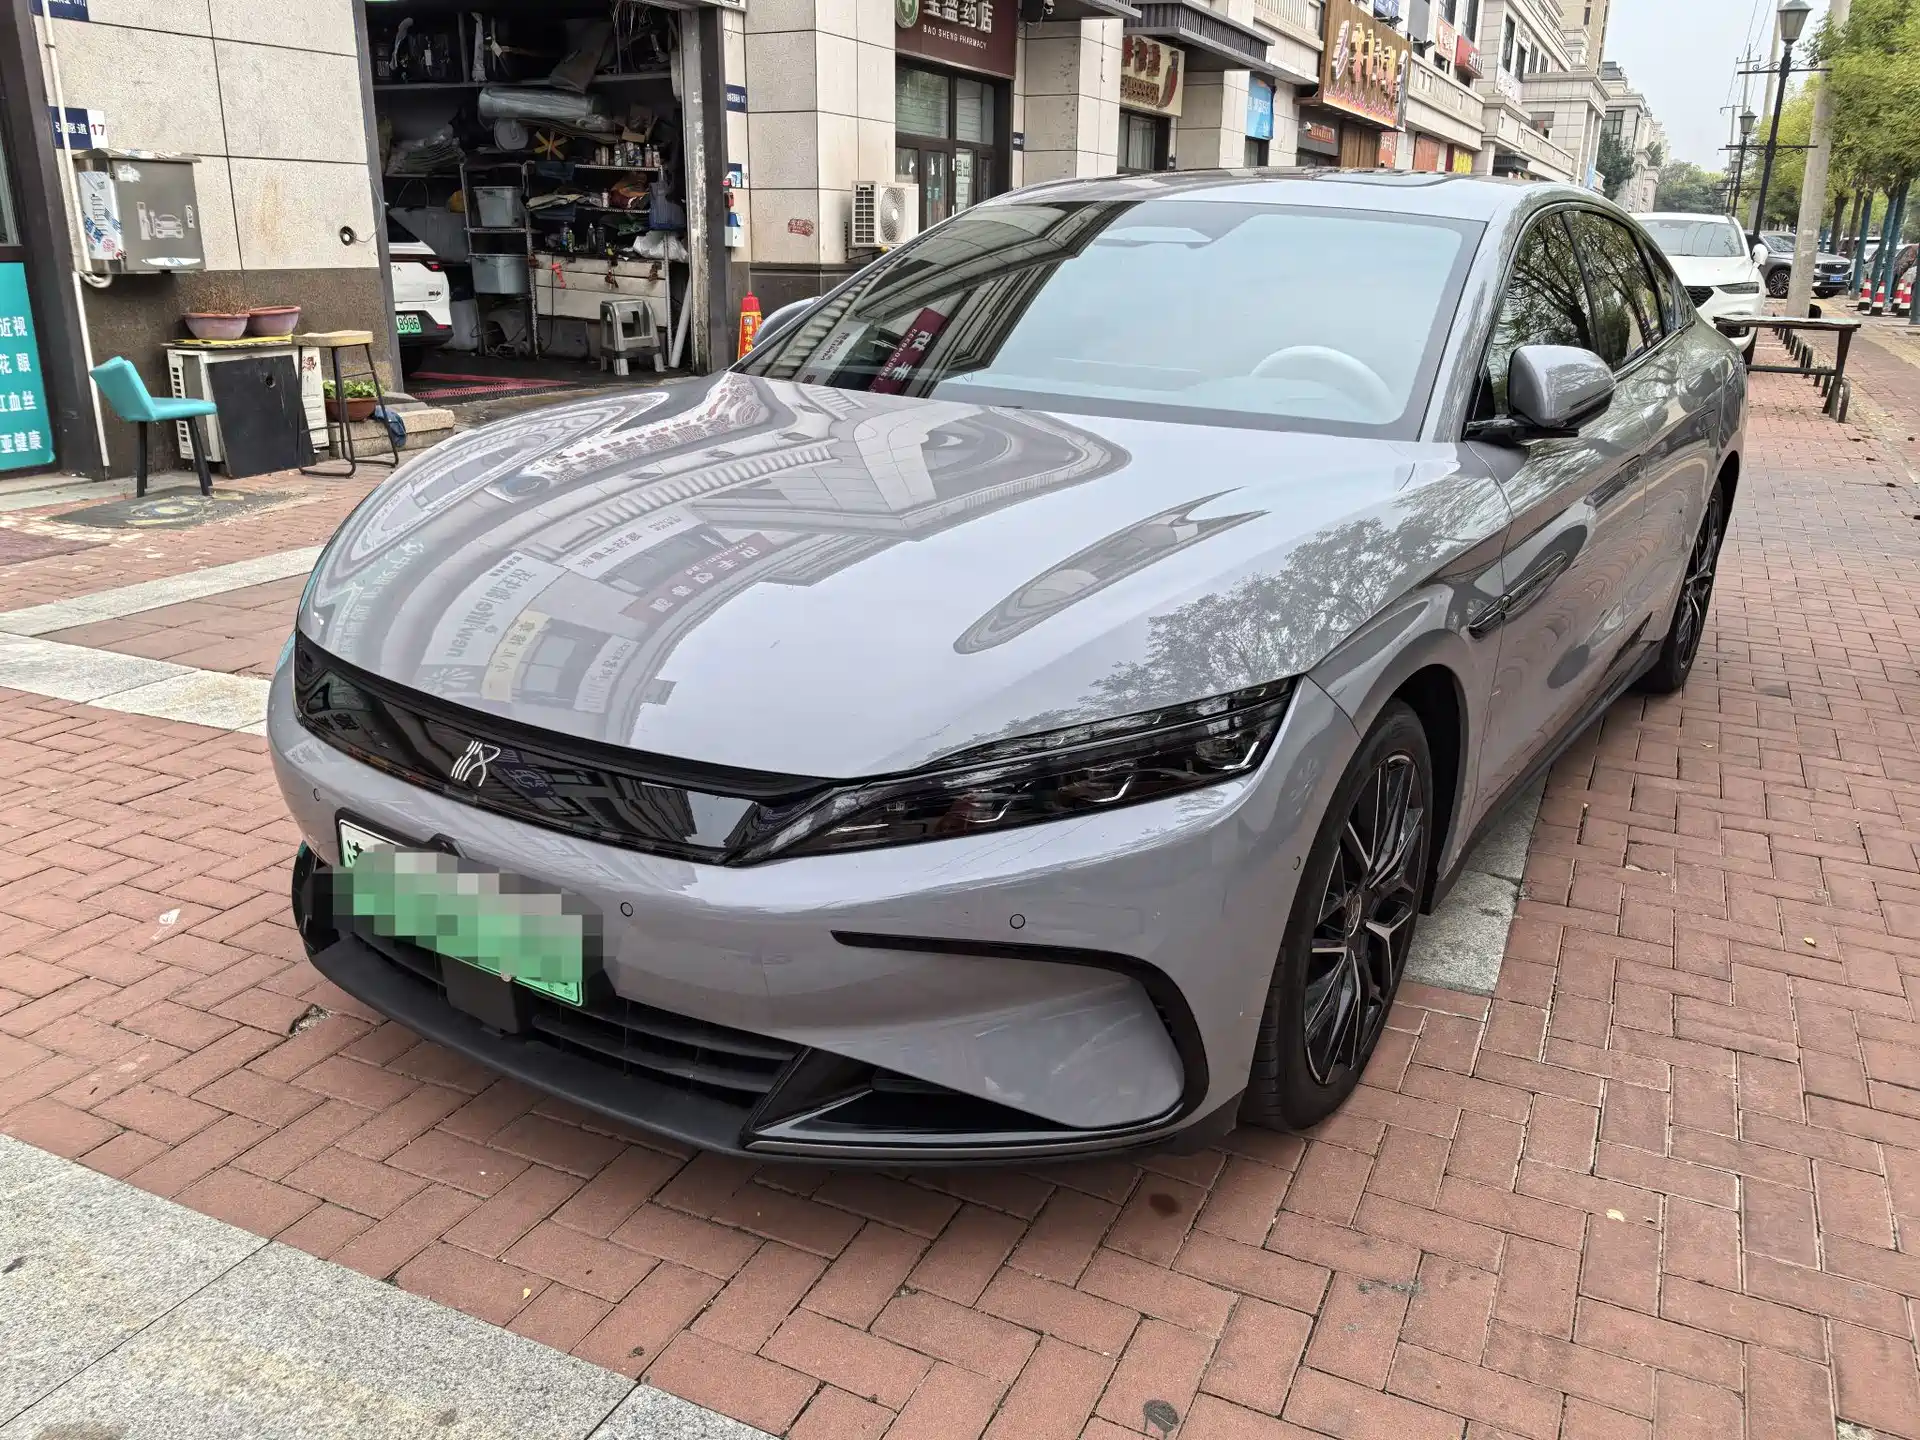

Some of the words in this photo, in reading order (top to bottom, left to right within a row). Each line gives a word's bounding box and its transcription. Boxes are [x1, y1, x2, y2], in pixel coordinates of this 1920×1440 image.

[923, 24, 936, 36] BAO
[938, 28, 958, 42] SHENG
[959, 35, 987, 49] PHARMACY
[91, 123, 105, 136] 17
